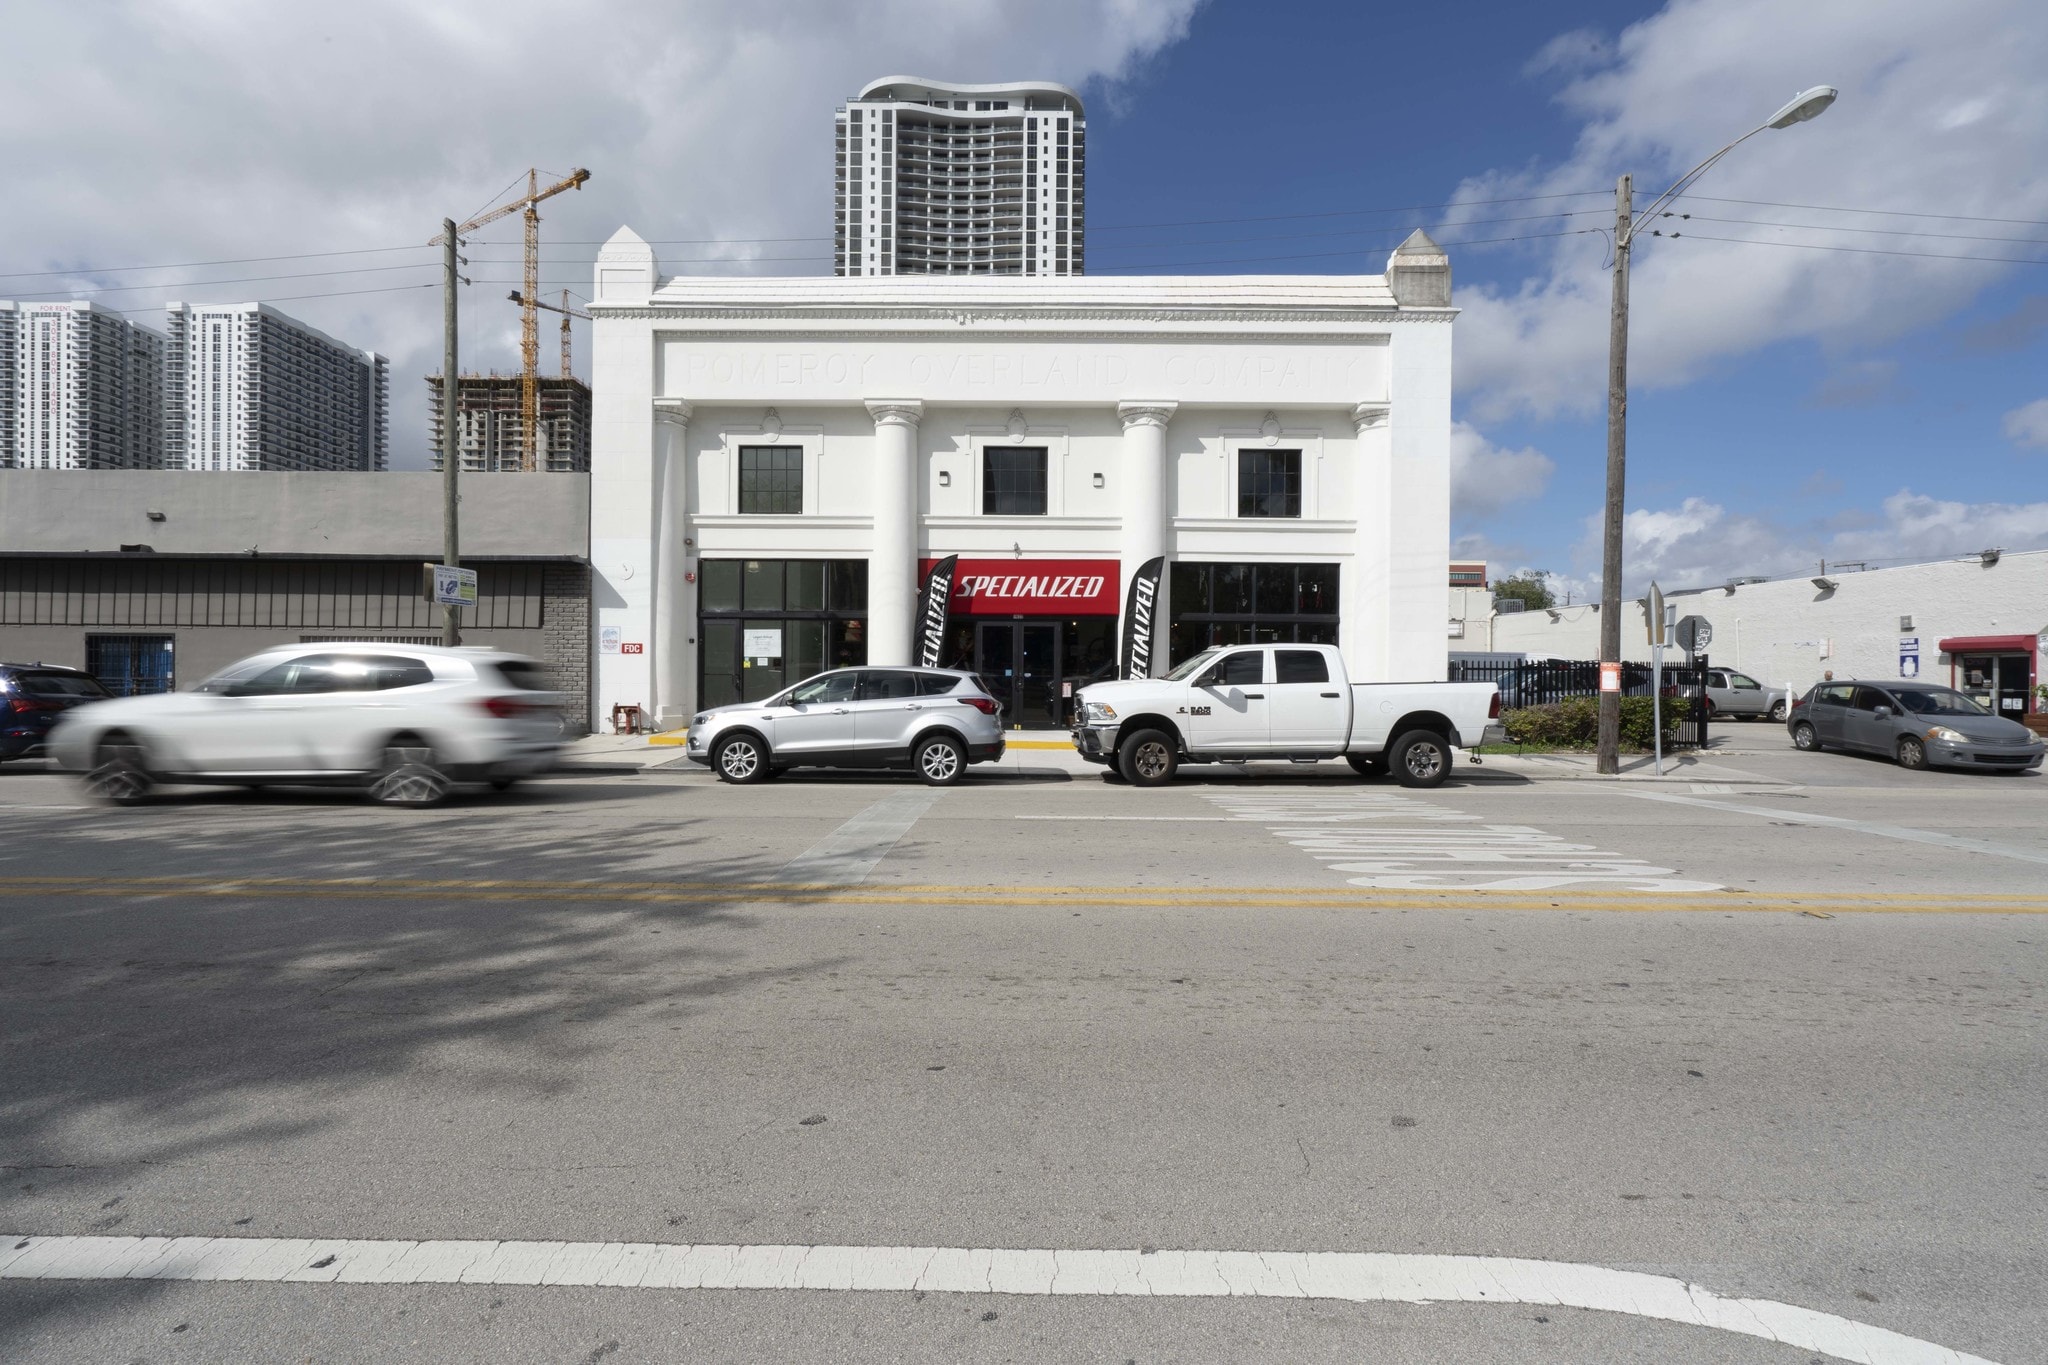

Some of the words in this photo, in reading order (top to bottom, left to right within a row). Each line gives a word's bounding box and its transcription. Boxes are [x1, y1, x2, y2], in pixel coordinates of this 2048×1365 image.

[687, 353, 877, 386] POMEROY
[910, 353, 1128, 386] OVERLAND
[1165, 355, 1361, 388] COMPANY
[955, 576, 1104, 597] SPECIALIZED
[1130, 577, 1154, 680] ECIALIZED
[624, 644, 640, 653] FDC
